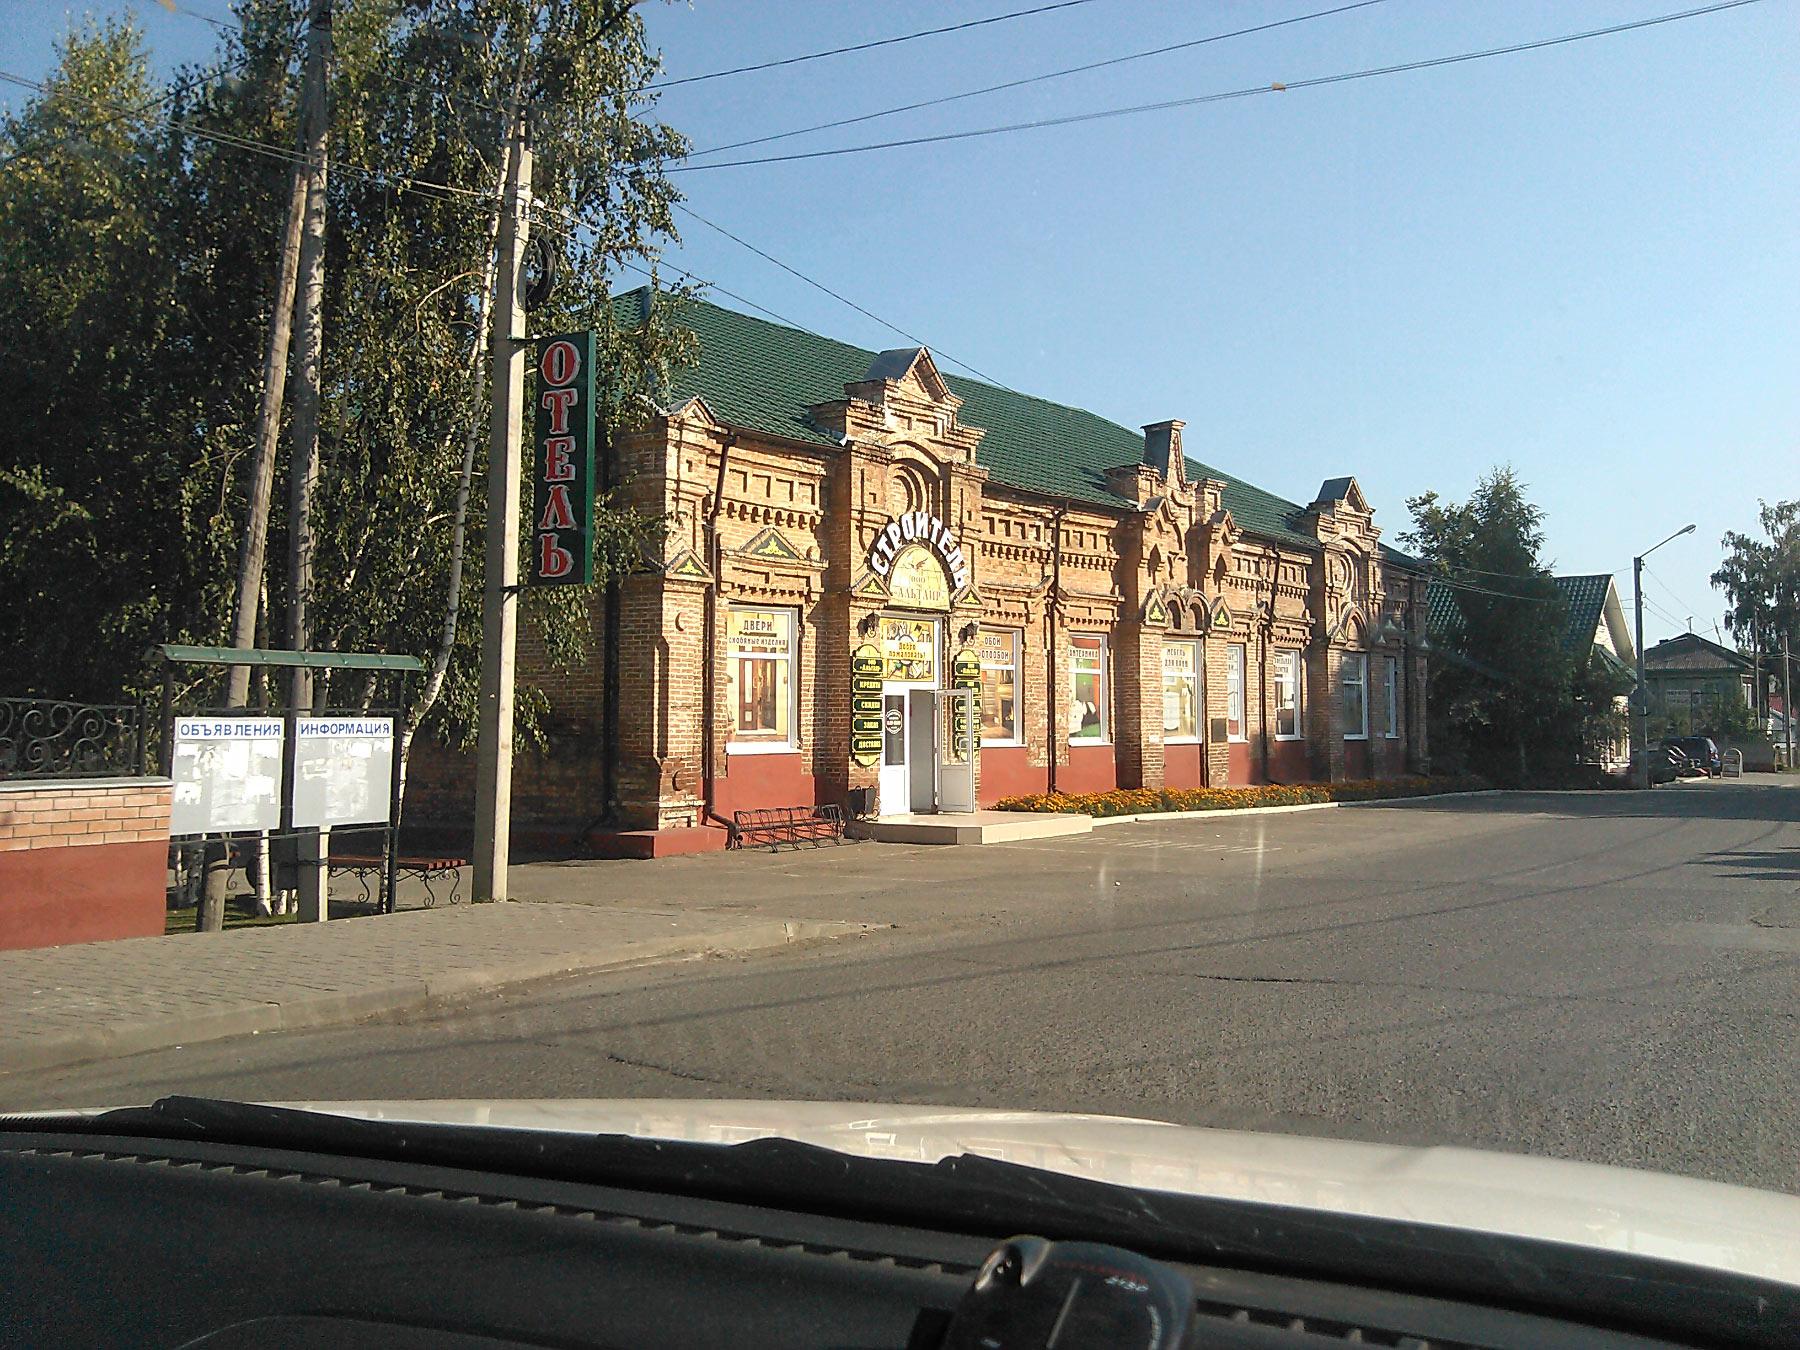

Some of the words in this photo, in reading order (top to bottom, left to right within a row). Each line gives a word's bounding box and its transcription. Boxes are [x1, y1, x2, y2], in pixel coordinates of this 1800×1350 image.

[538, 340, 582, 578] ОТЕЛЬ
[870, 511, 969, 589] СТРОИТЕЛЬ
[743, 619, 773, 631] ДВЕРИ
[728, 636, 759, 645] скобяные
[760, 638, 786, 646] изделия
[898, 642, 916, 650] Добро
[984, 636, 1000, 646] ОБОИ
[888, 650, 926, 659] пожаловать!
[180, 723, 281, 736] ОБЪЯВЛЕНИЯ
[300, 722, 390, 735] ИНФОРМАЦИЯ
